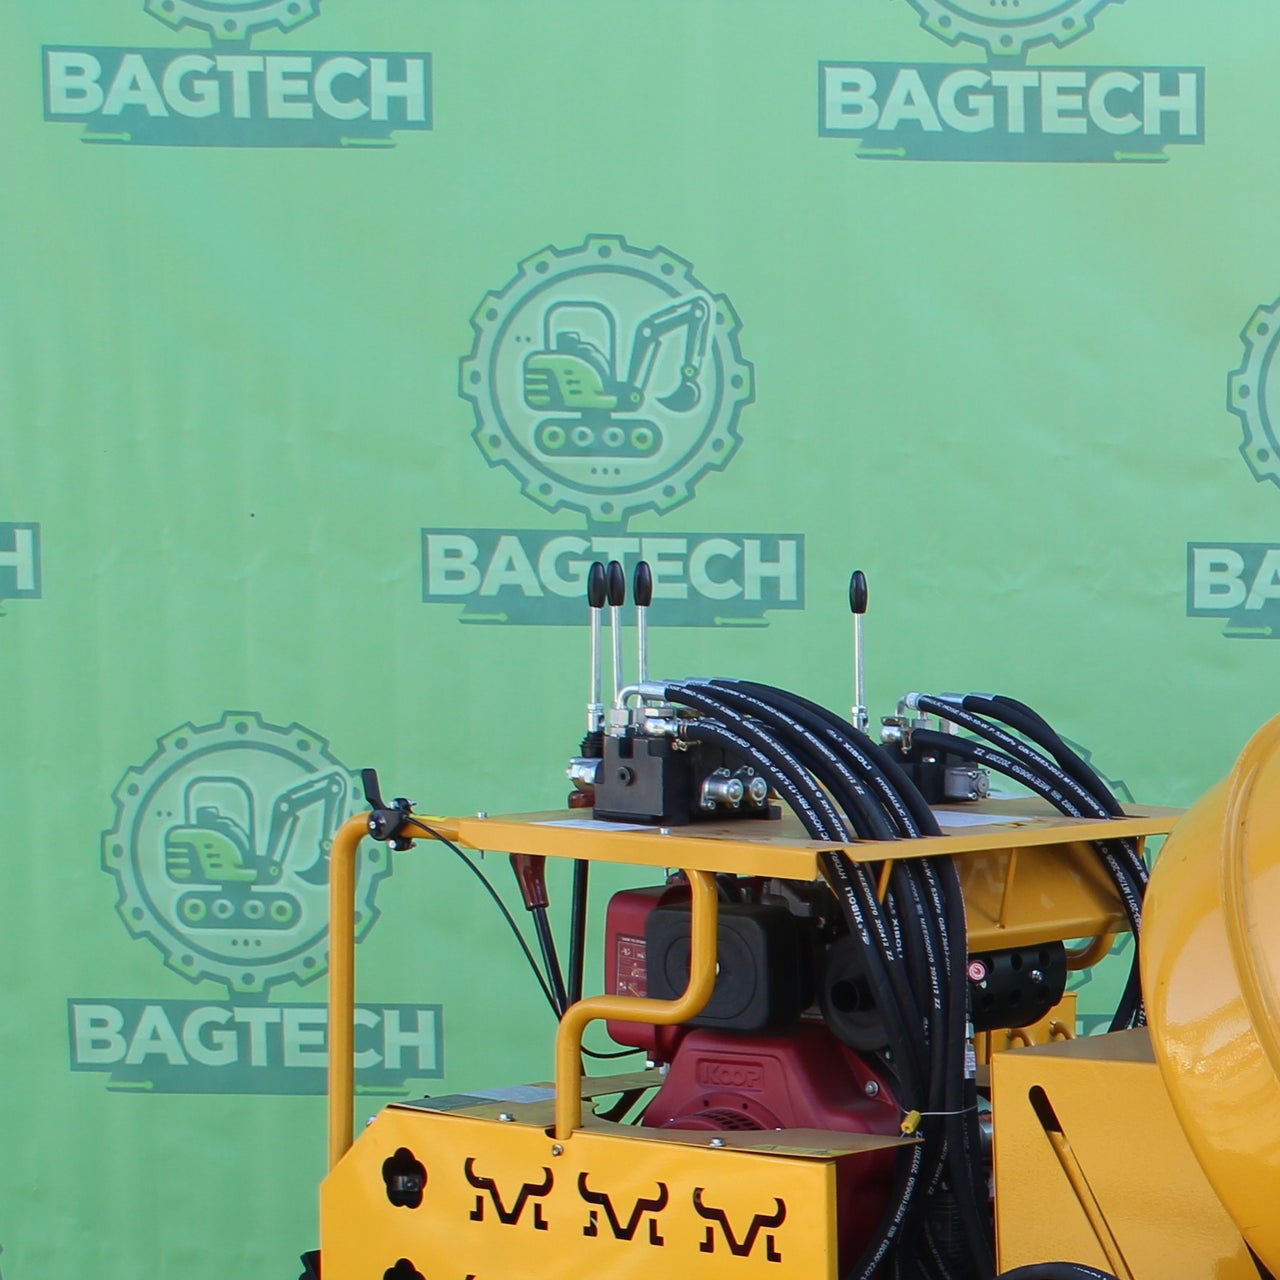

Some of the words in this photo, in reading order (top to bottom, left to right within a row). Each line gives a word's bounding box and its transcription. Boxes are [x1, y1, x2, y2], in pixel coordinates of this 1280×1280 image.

[48, 51, 425, 123] BAGTECH
[825, 67, 1197, 136] BAGTECH
[842, 741, 872, 771] XIBOLI
